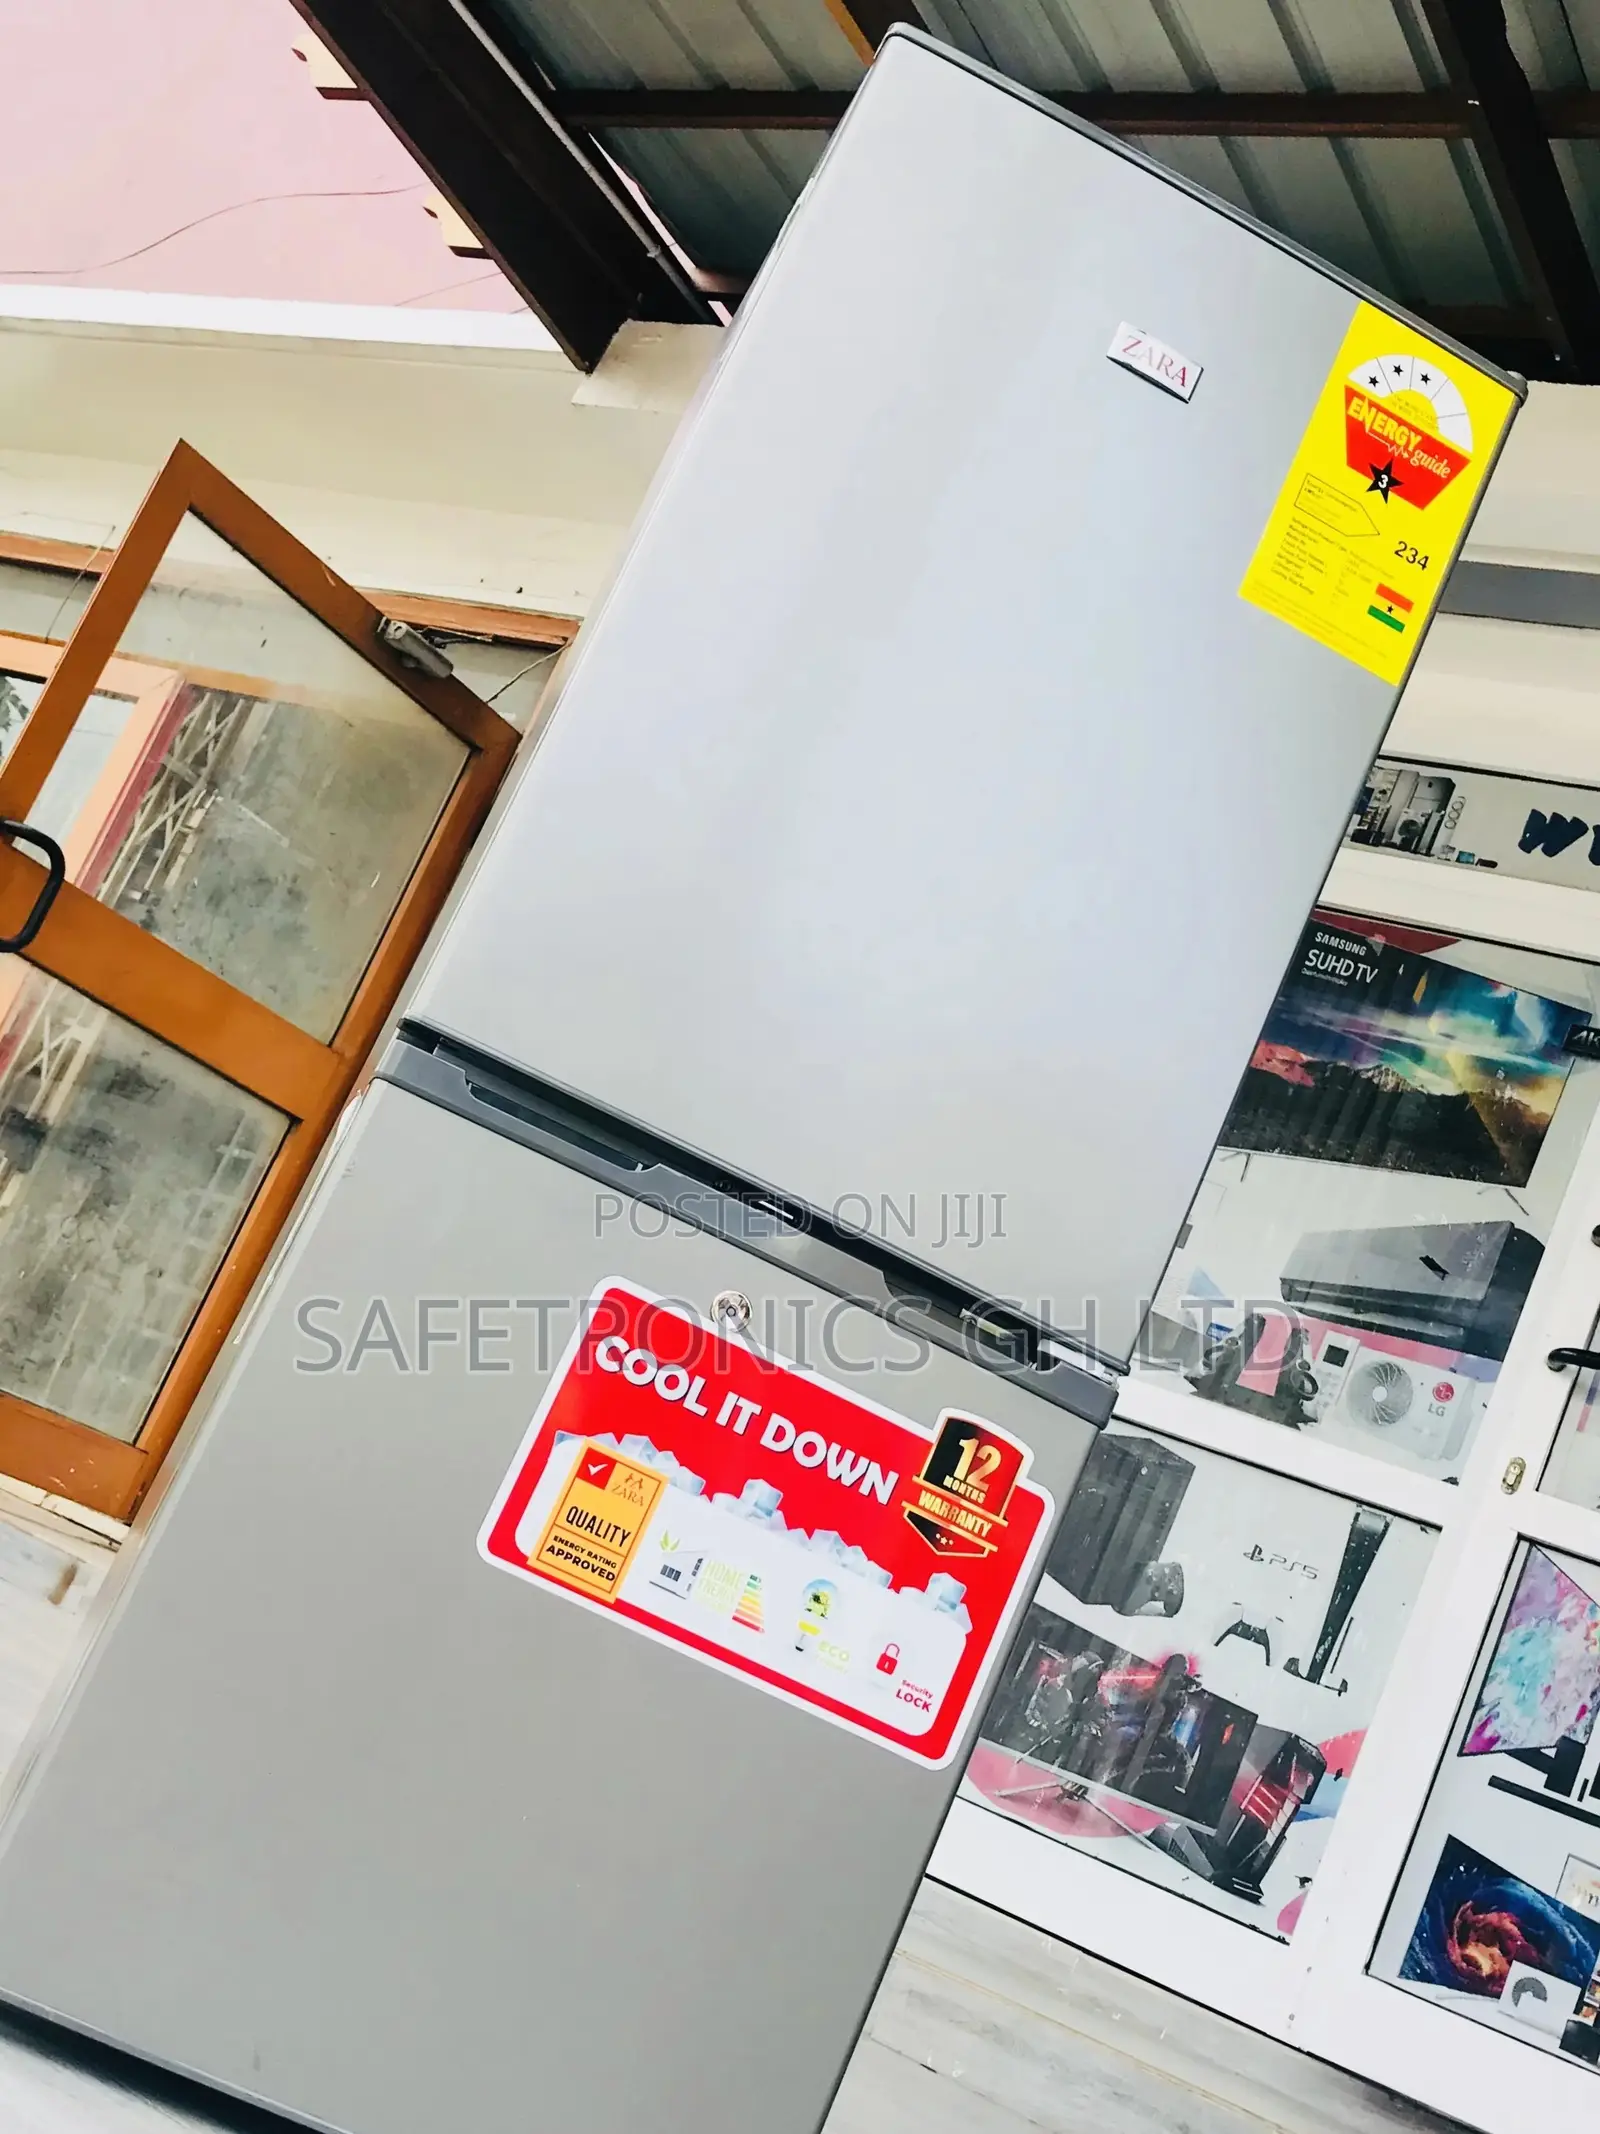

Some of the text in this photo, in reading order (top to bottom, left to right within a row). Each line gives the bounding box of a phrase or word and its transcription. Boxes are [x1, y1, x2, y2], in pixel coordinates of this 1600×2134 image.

[1121, 334, 1187, 388] ZARA
[1346, 397, 1422, 452] ENERGY
[1409, 449, 1451, 478] guide
[1377, 474, 1389, 489] 3
[1393, 540, 1430, 571] 234
[1314, 931, 1367, 957] SAMSUNG
[1304, 949, 1354, 977] SUHD
[1355, 963, 1379, 984] TV
[595, 1335, 899, 1506] COOL IT DOWN
[1427, 1403, 1447, 1418] LG
[952, 1437, 1002, 1494] 12
[610, 1481, 645, 1508] ZARA
[943, 1474, 987, 1505] MONTHS
[564, 1505, 632, 1548] QUALITY
[918, 1490, 993, 1539] WARRANTY
[545, 1543, 616, 1583] APPROVED
[552, 1534, 618, 1569] ENERGY RATING
[1268, 1552, 1320, 1581] PS5
[895, 1688, 933, 1713] LOCK
[901, 1678, 934, 1700] Security
